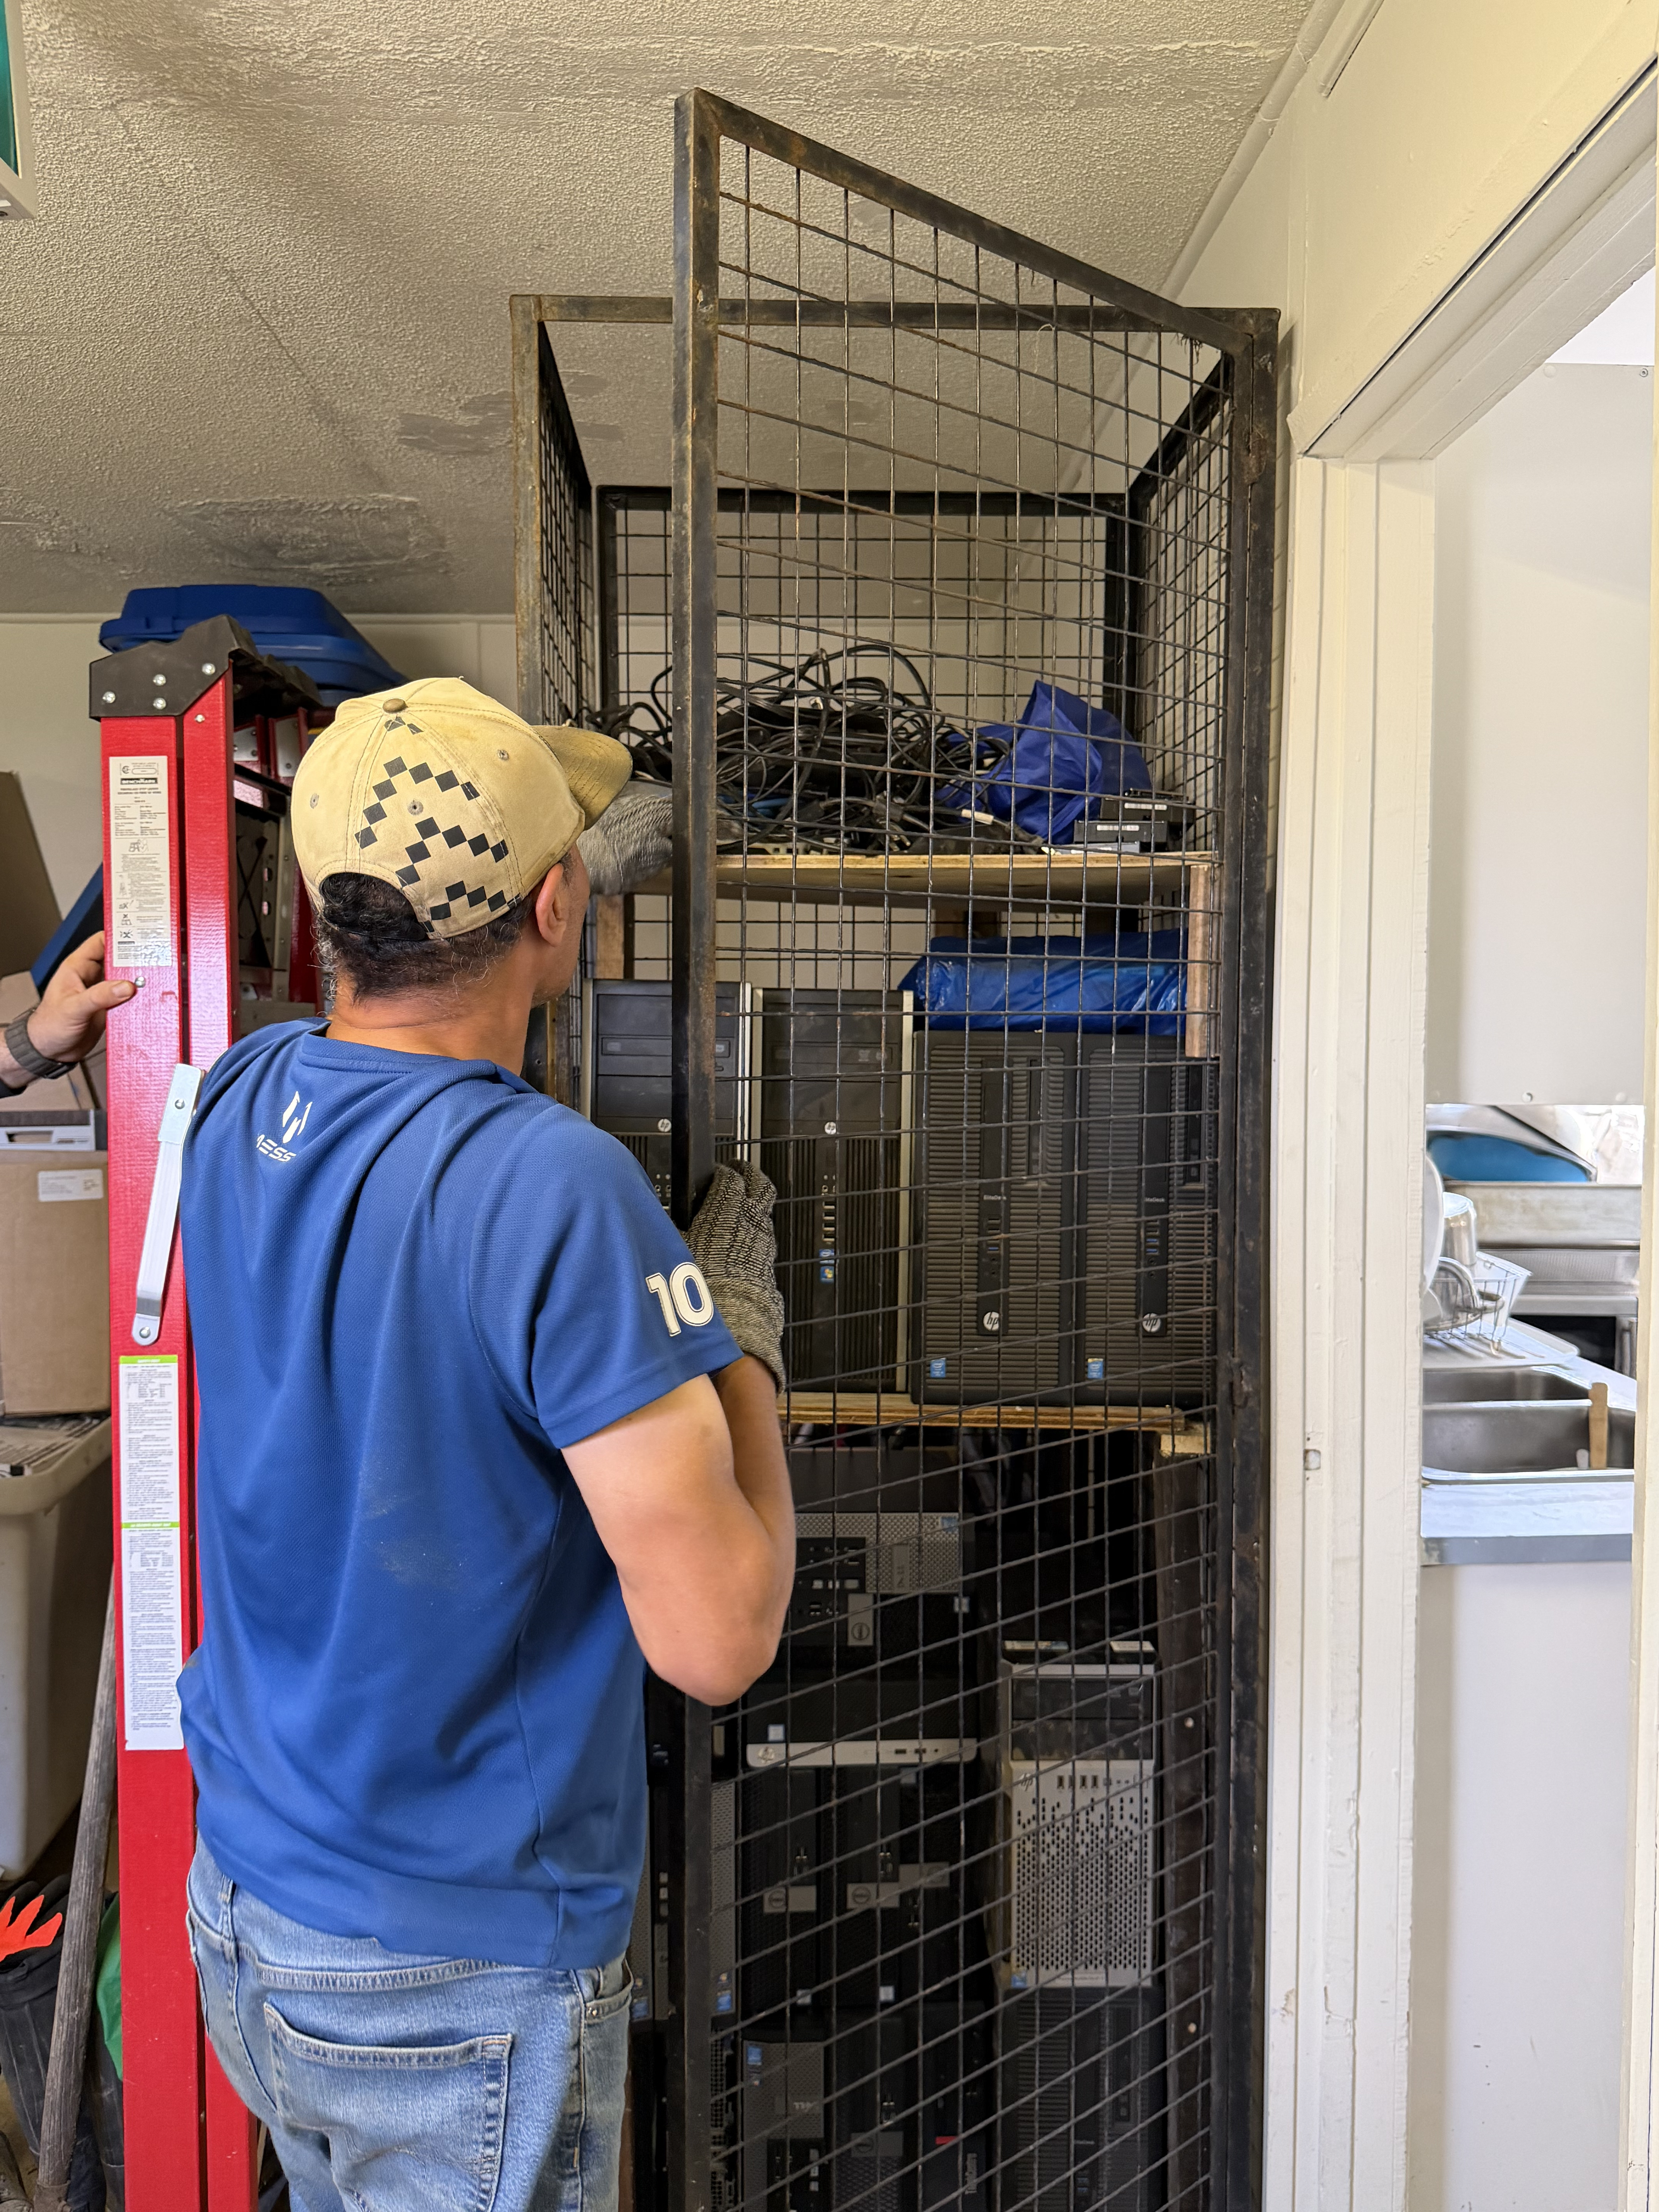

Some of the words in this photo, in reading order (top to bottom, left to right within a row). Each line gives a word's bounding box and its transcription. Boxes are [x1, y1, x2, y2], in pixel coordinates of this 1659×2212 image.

[659, 1119, 670, 1132] hp
[826, 1122, 836, 1134] hp
[646, 1262, 714, 1337] 10
[986, 1312, 999, 1330] hp
[1144, 1313, 1159, 1332] hp
